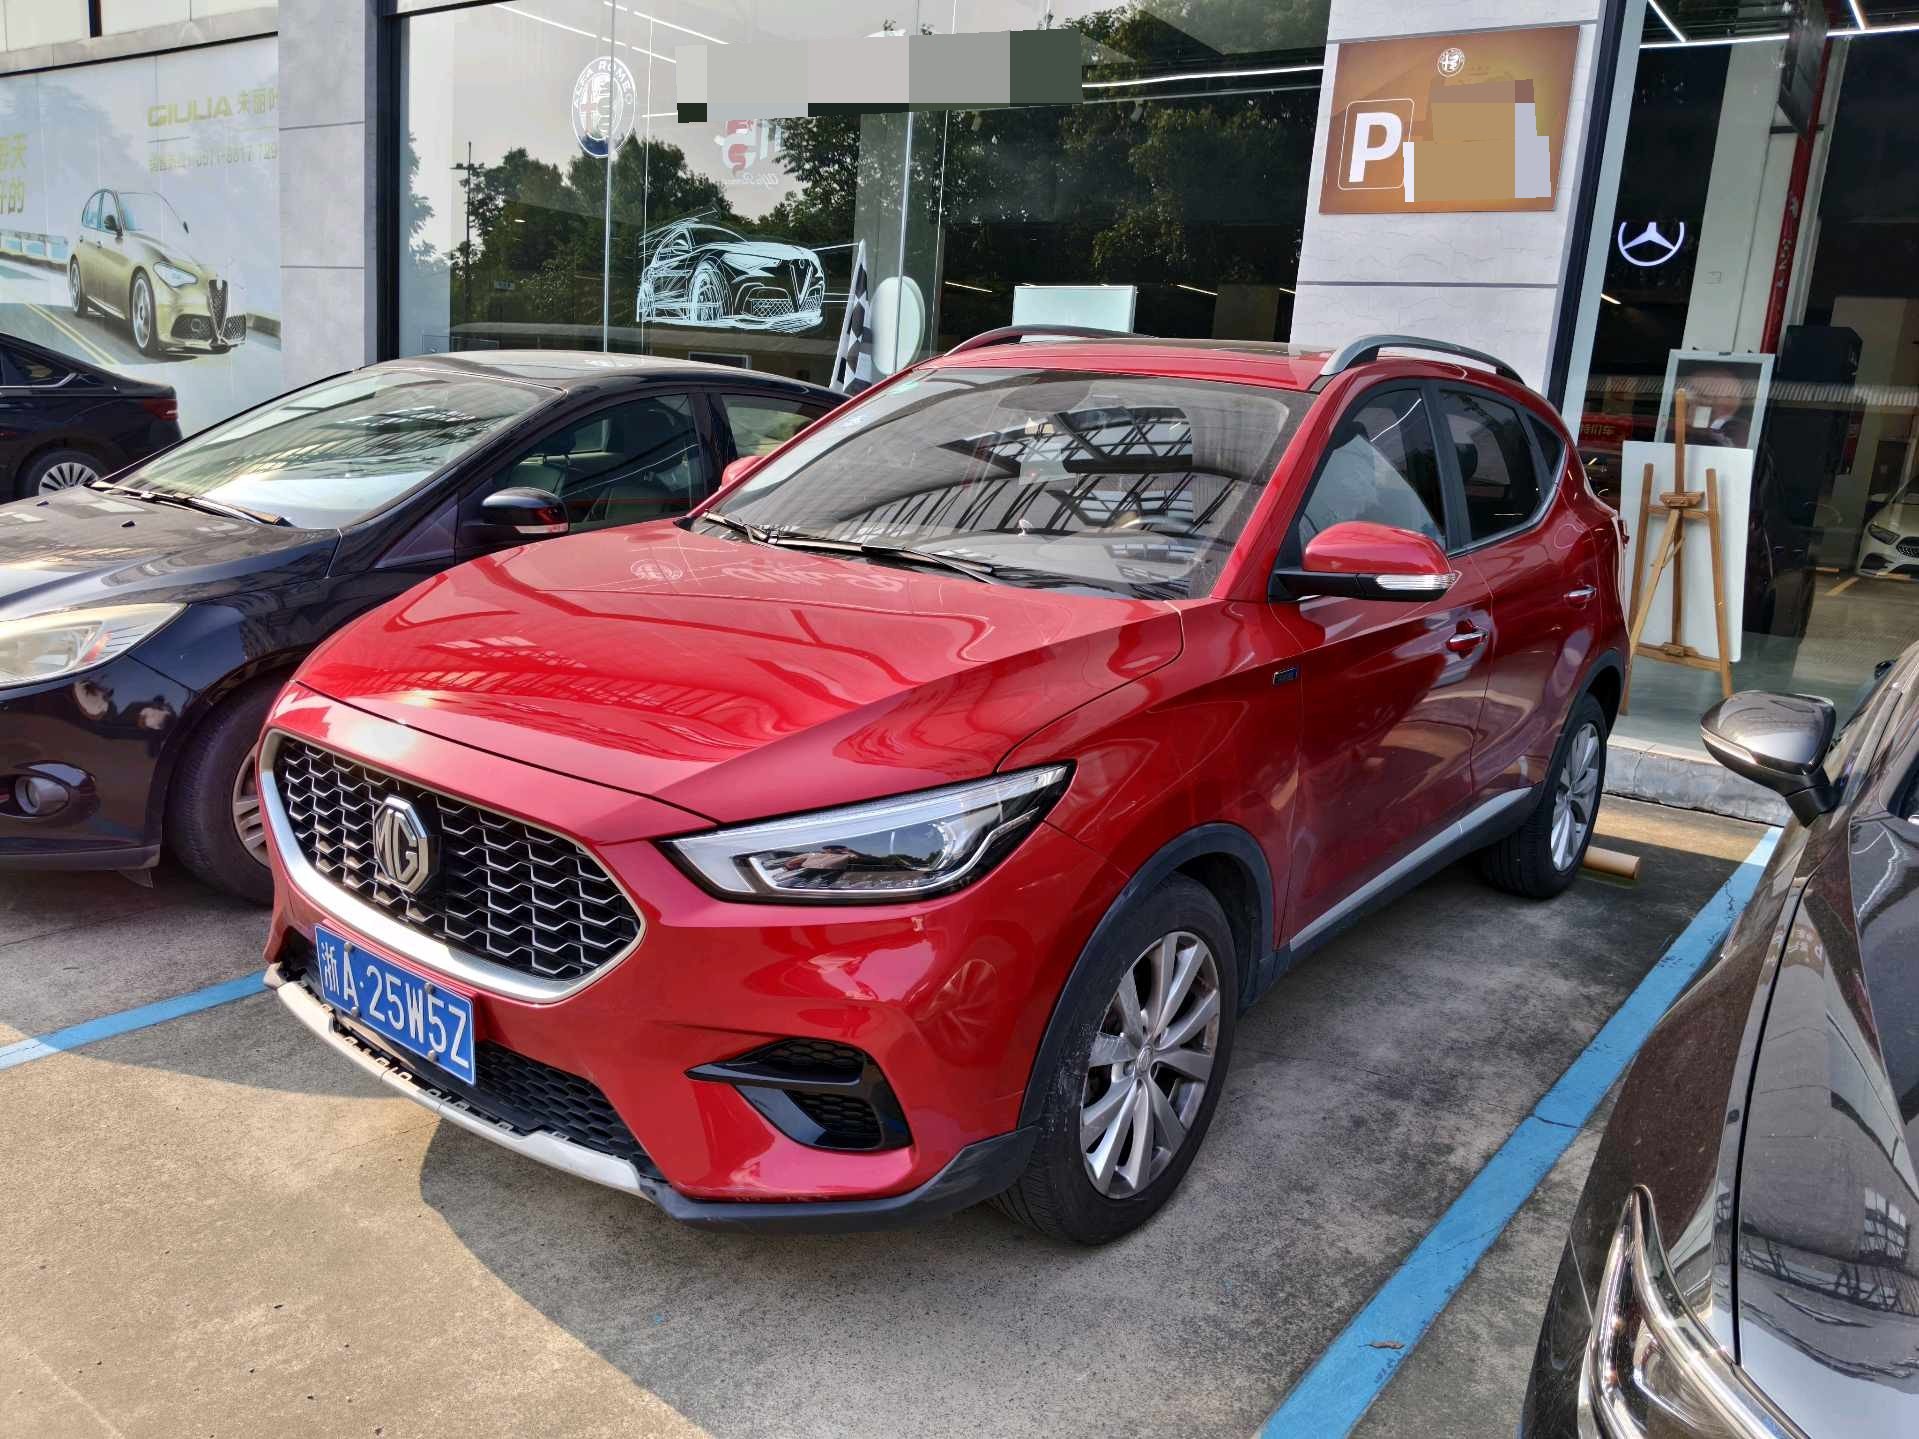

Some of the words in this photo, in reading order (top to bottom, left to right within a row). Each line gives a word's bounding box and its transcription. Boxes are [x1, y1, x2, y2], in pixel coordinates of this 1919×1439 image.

[597, 60, 633, 105] ROMEO
[148, 96, 232, 128] GIULIA
[1348, 112, 1402, 182] P
[374, 806, 419, 883] MG
